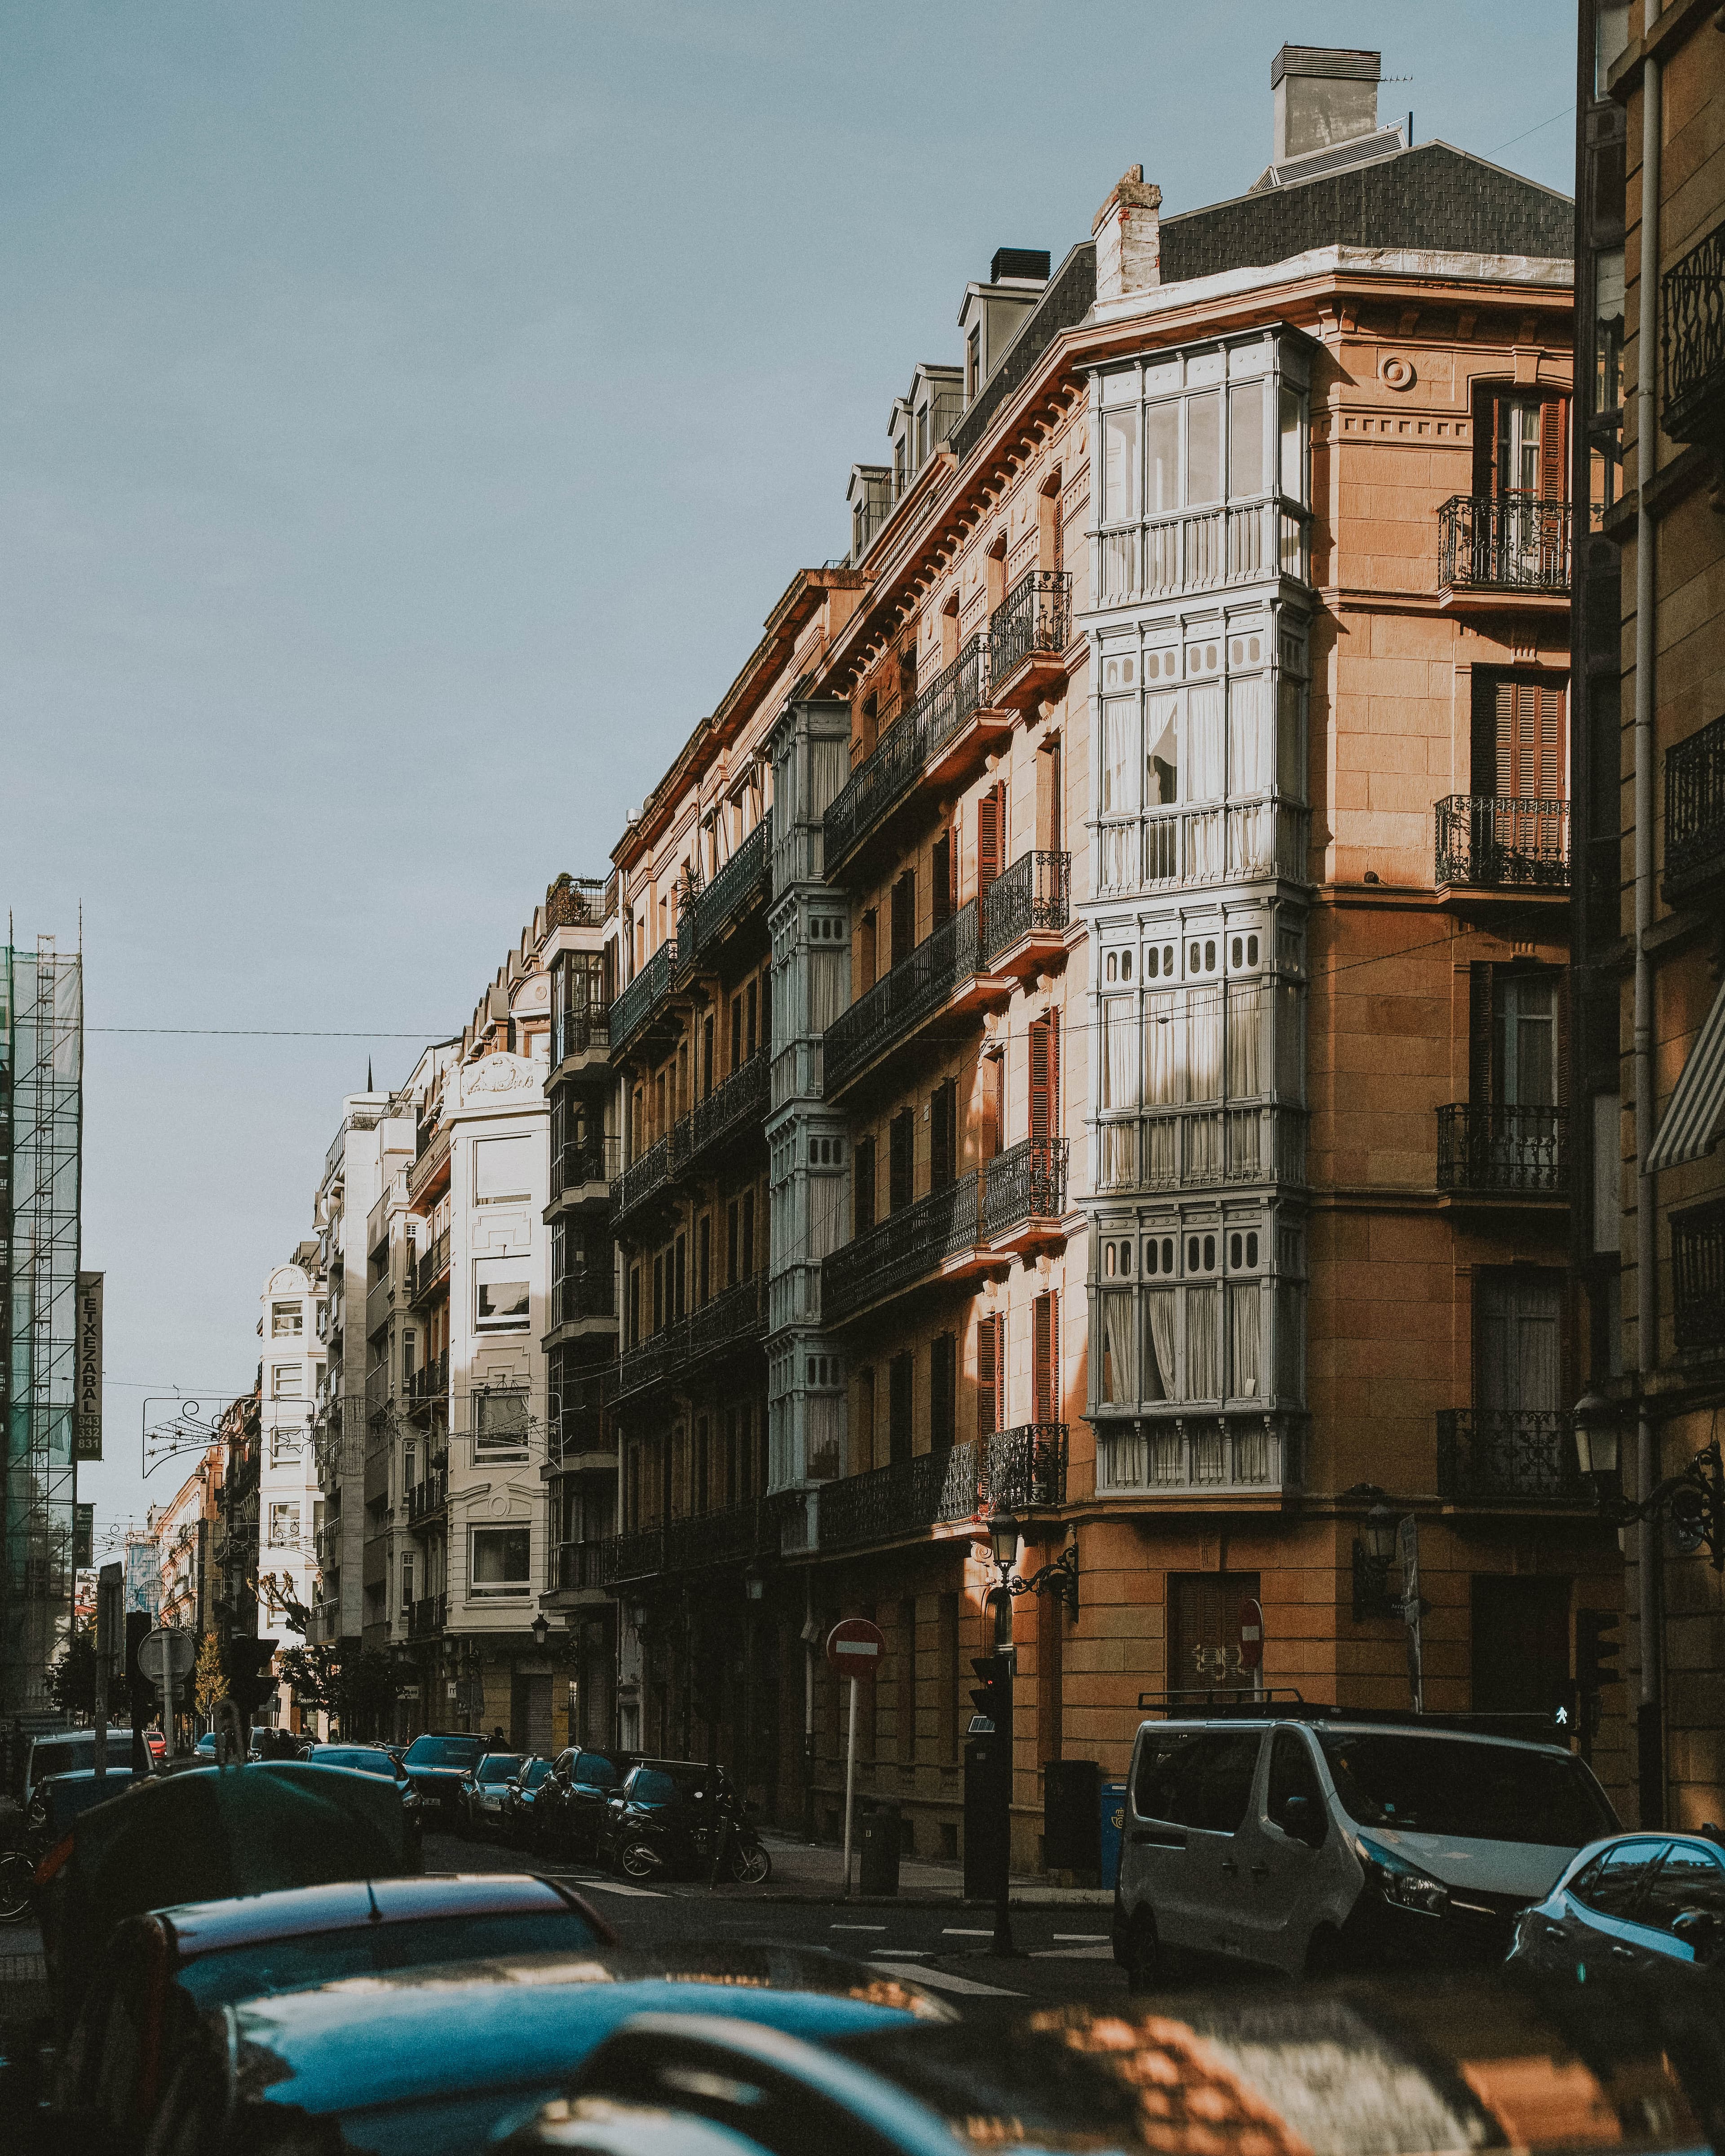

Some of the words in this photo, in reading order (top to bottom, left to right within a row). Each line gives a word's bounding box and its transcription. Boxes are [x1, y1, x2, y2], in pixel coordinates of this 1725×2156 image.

[82, 1298, 97, 1413] ETXEZABAL
[78, 1416, 100, 1426] 943
[79, 1427, 100, 1437] 332
[78, 1439, 99, 1449] 831
